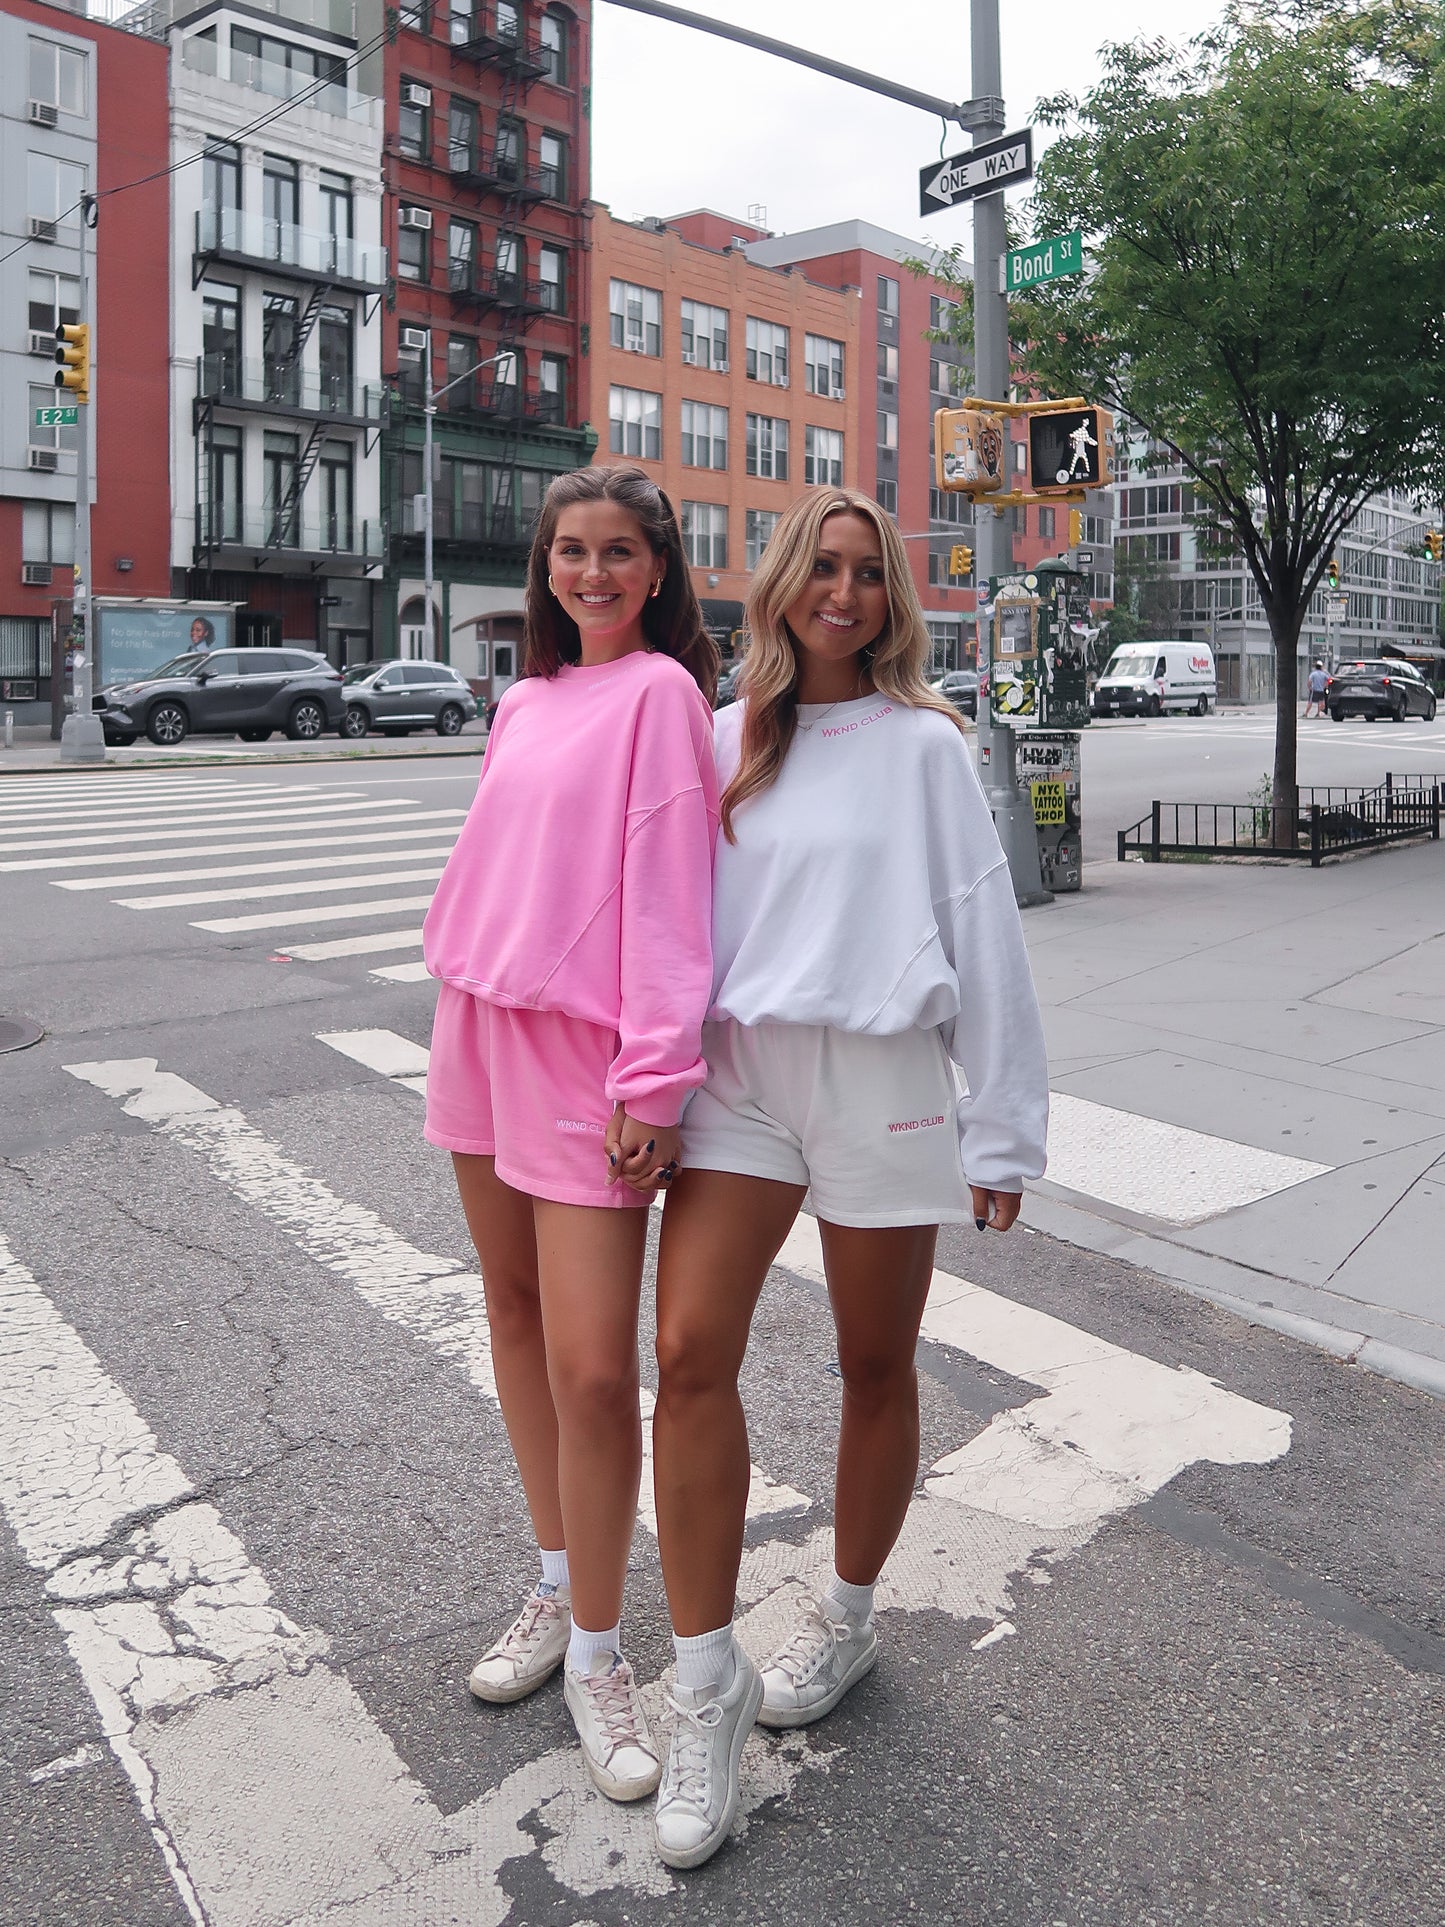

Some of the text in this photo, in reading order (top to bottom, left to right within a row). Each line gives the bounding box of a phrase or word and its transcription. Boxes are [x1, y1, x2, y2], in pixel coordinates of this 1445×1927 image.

[940, 149, 1019, 194] ONE WAY
[1013, 239, 1073, 284] Bond St
[41, 409, 76, 425] E 2 ST
[111, 628, 182, 638] No one has time
[111, 639, 126, 648] for
[126, 639, 141, 648] the
[1192, 656, 1209, 670] Ryder
[822, 706, 893, 738] WKND CLUB
[1038, 784, 1060, 796] NYC
[1034, 796, 1063, 809] TATTOO
[1035, 810, 1063, 821] SHOP
[556, 1119, 587, 1131] WKND
[888, 1115, 945, 1133] WKND CLUB
